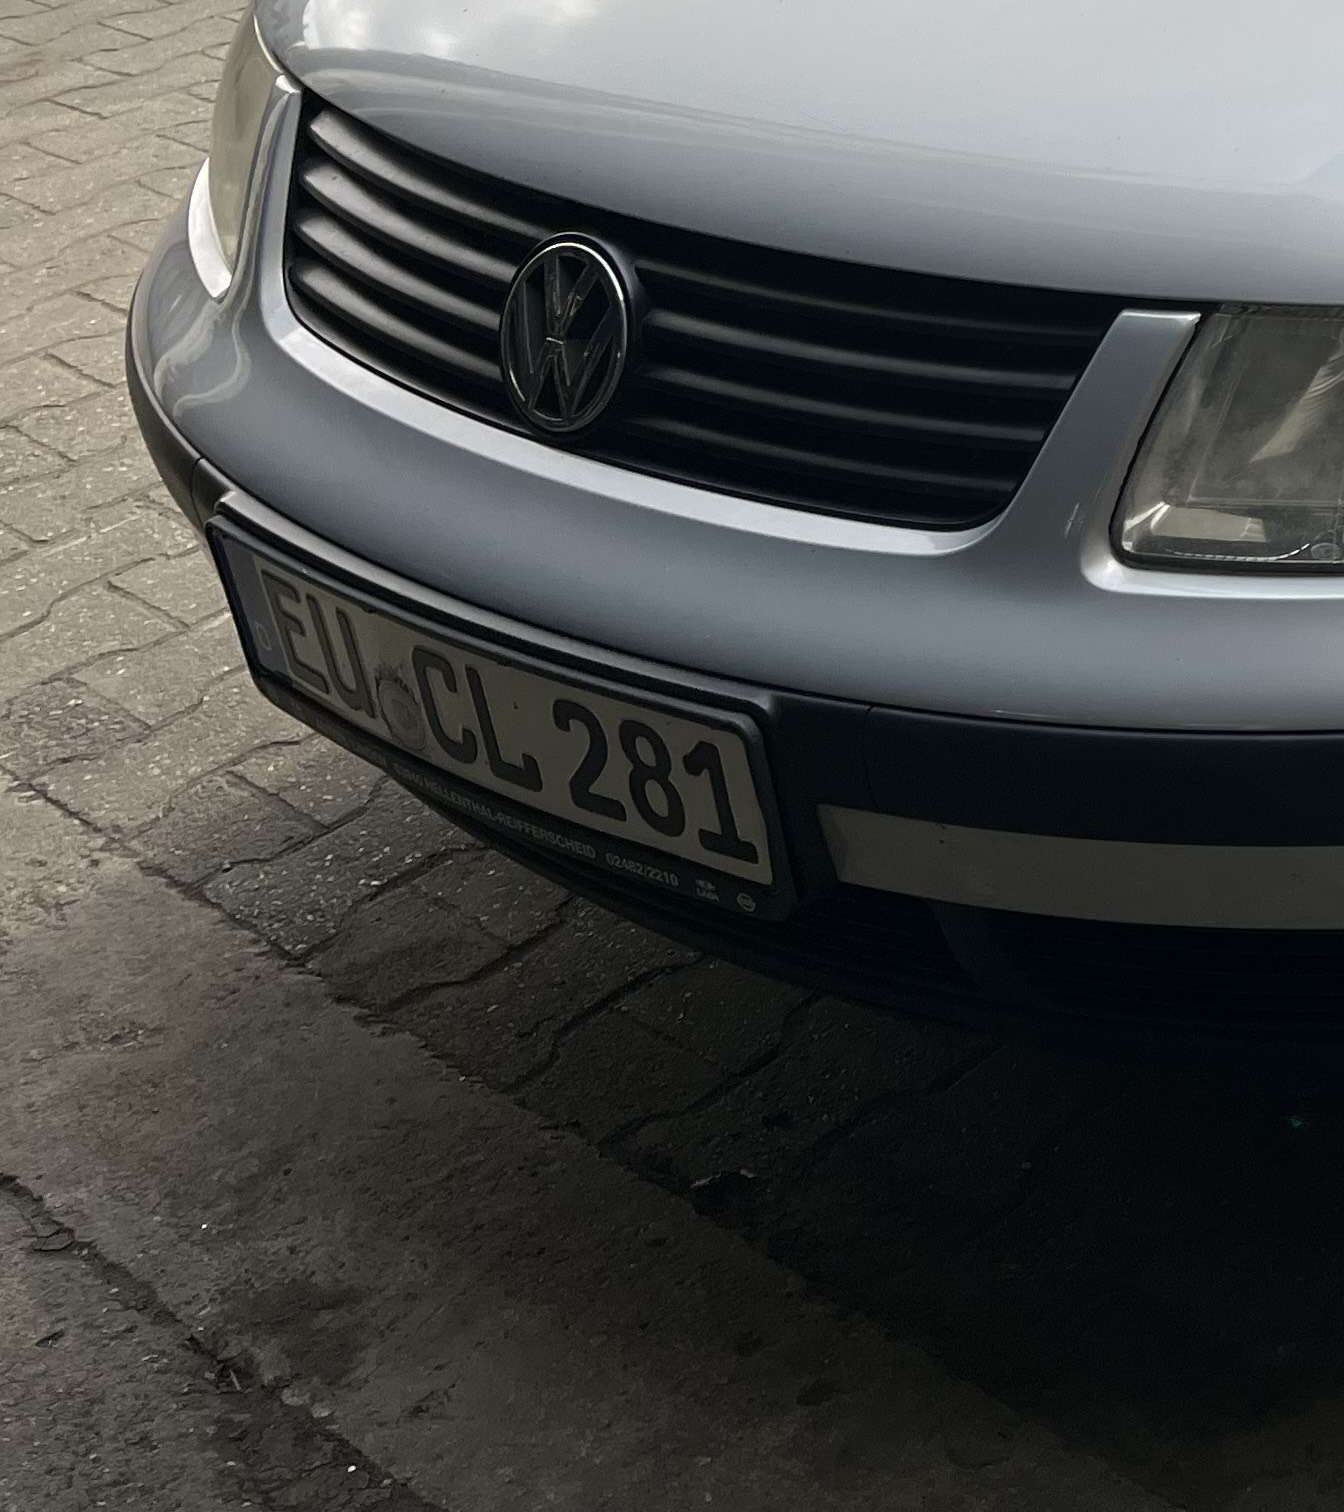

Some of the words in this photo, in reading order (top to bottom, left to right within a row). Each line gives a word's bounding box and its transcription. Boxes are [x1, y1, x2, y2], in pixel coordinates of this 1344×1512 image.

[261, 569, 376, 718] EU
[411, 645, 543, 793] CL
[552, 698, 759, 865] 281
